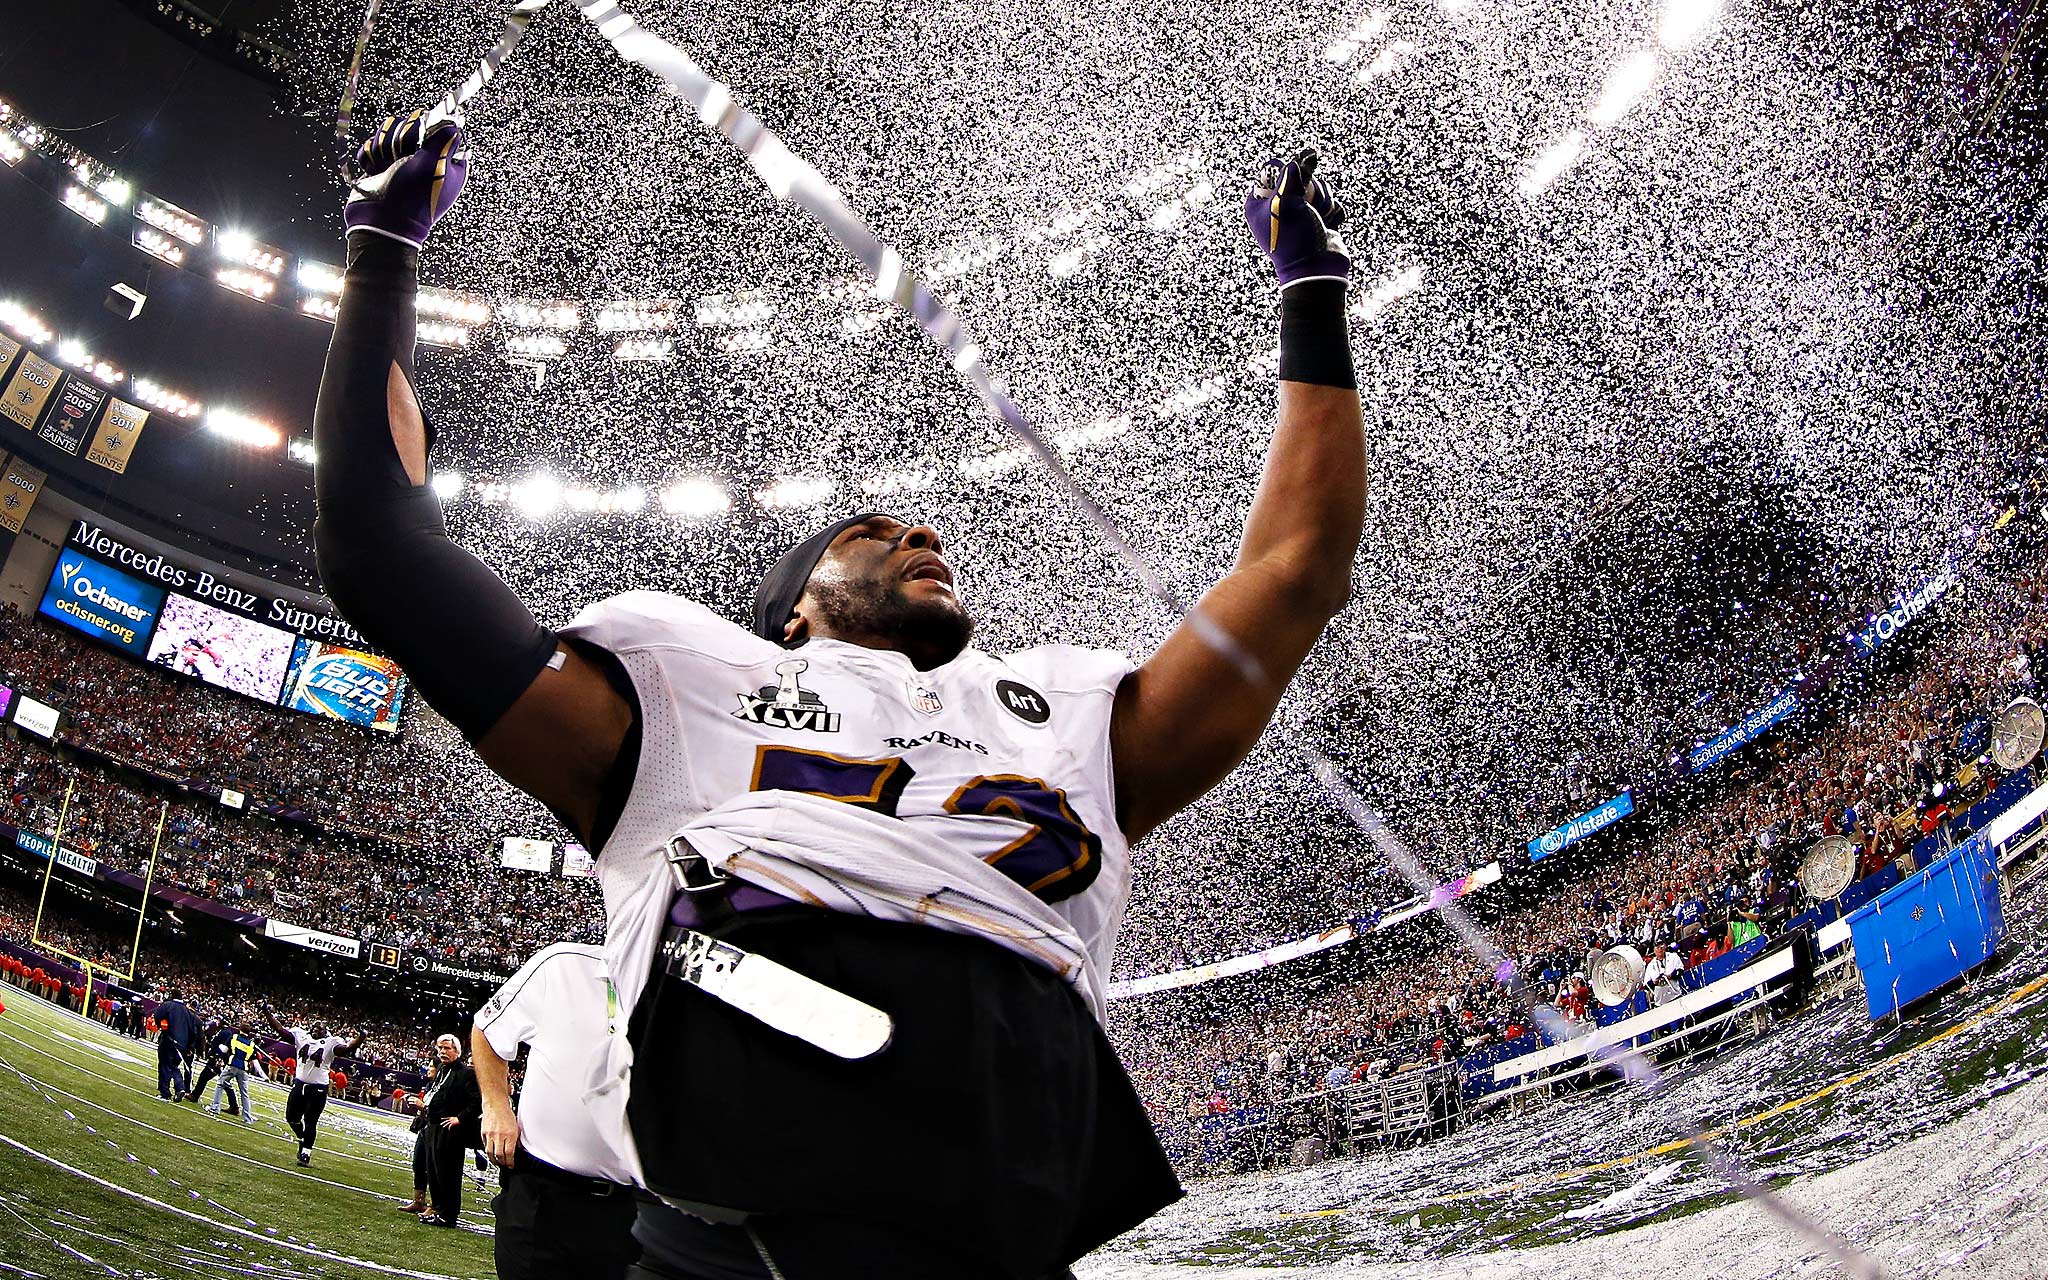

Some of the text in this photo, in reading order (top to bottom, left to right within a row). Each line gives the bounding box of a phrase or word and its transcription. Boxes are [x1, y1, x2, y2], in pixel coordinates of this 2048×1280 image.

[22, 368, 49, 388] 2009
[76, 380, 97, 395] WORLD
[63, 391, 93, 412] 2009
[67, 382, 101, 403] CHAMPIONS
[0, 403, 32, 427] SAINTS
[110, 415, 136, 432] 2011
[42, 428, 77, 452] SAINTS
[88, 451, 123, 471] SAINTS
[8, 472, 36, 493] 2000
[0, 514, 19, 531] NTS
[71, 520, 257, 612] Mercedes-Benz
[73, 577, 148, 622] Ochsner
[55, 598, 136, 645] ochsner.org
[320, 662, 389, 696] BUD
[306, 673, 388, 710] LIGHT
[915, 696, 940, 711] NFL
[1006, 689, 1042, 713] Art
[19, 713, 50, 732] verizon
[730, 693, 841, 733] XLVII
[1747, 694, 1797, 732] SEAFOOD
[883, 730, 989, 756] RAVENS
[85, 742, 104, 753] SAN
[103, 750, 153, 772] FRANCISCO
[1564, 805, 1618, 846] Allstate
[60, 850, 95, 874] HEALTH
[307, 934, 355, 956] verizon
[378, 947, 397, 966] 13
[431, 961, 509, 984] Mercedes-Benz
[297, 1043, 325, 1069] 44
